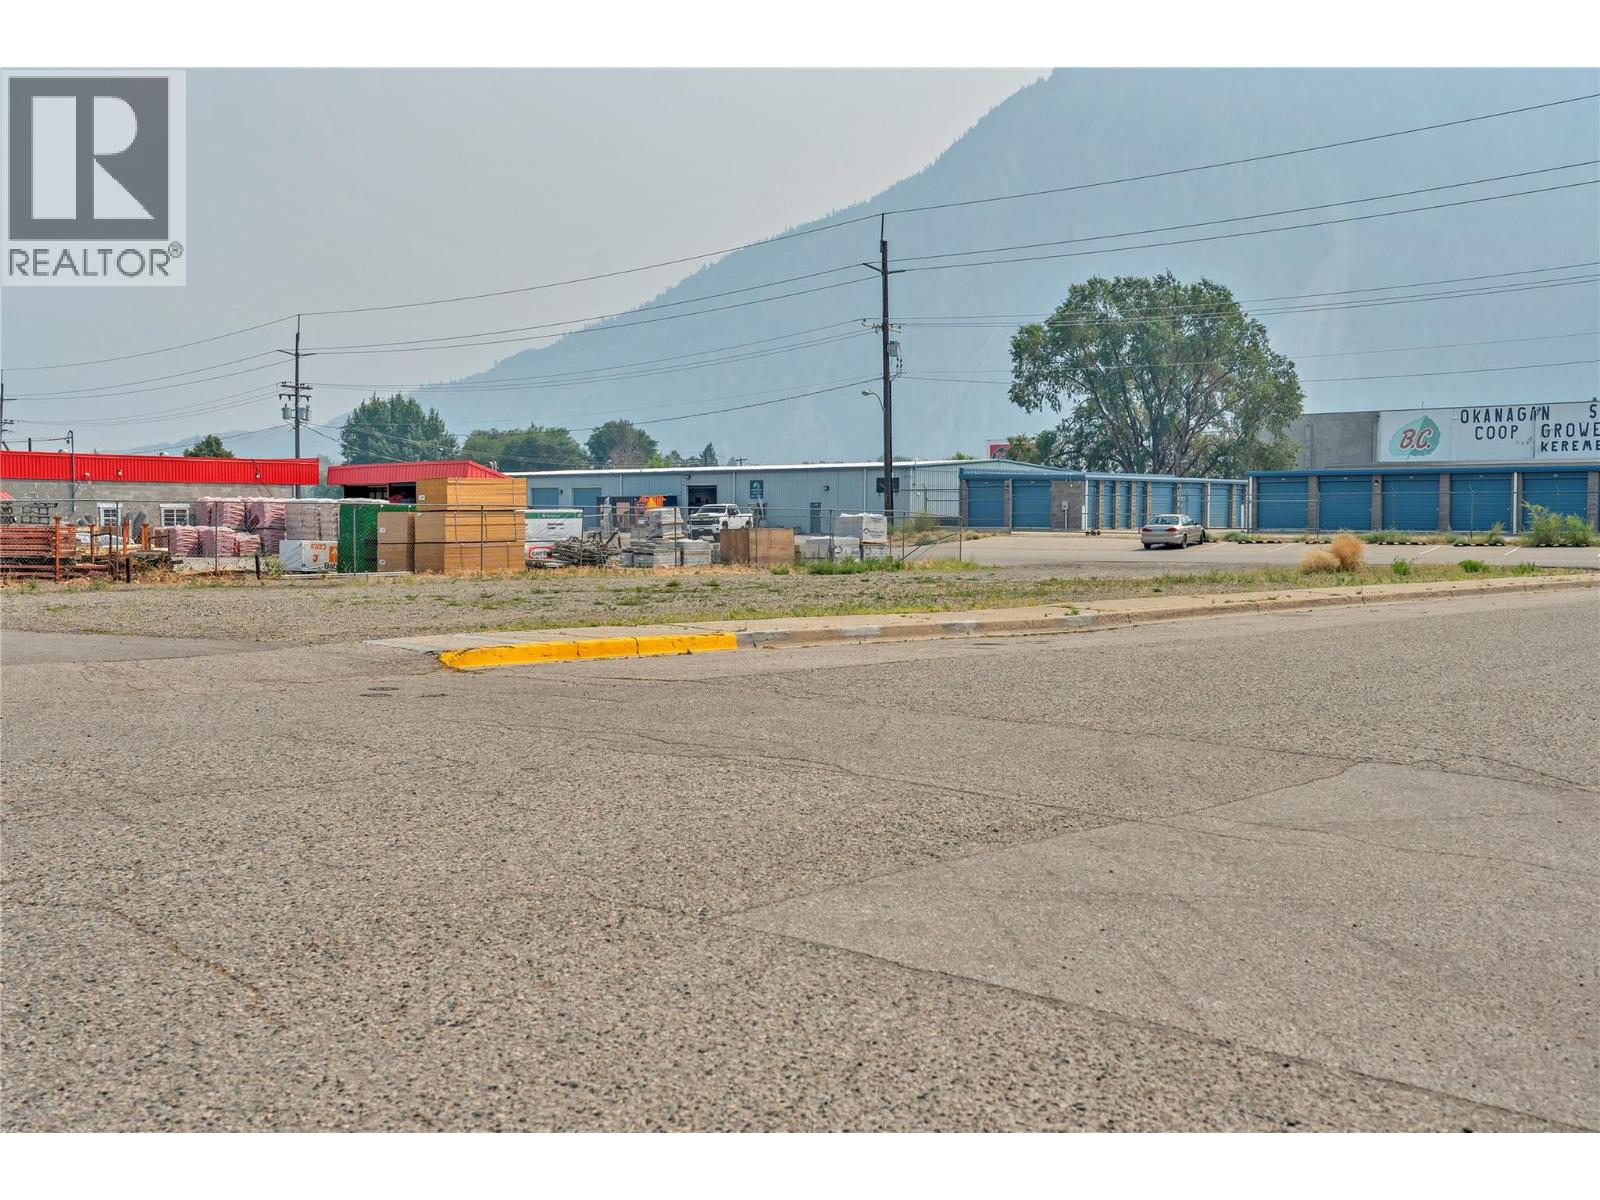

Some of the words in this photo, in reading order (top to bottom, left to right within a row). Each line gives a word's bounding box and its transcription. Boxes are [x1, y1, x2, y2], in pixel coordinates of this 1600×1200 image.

[1460, 405, 1550, 424] OKANAGAN
[1400, 427, 1433, 450] B.C.
[1475, 425, 1519, 441] COOP
